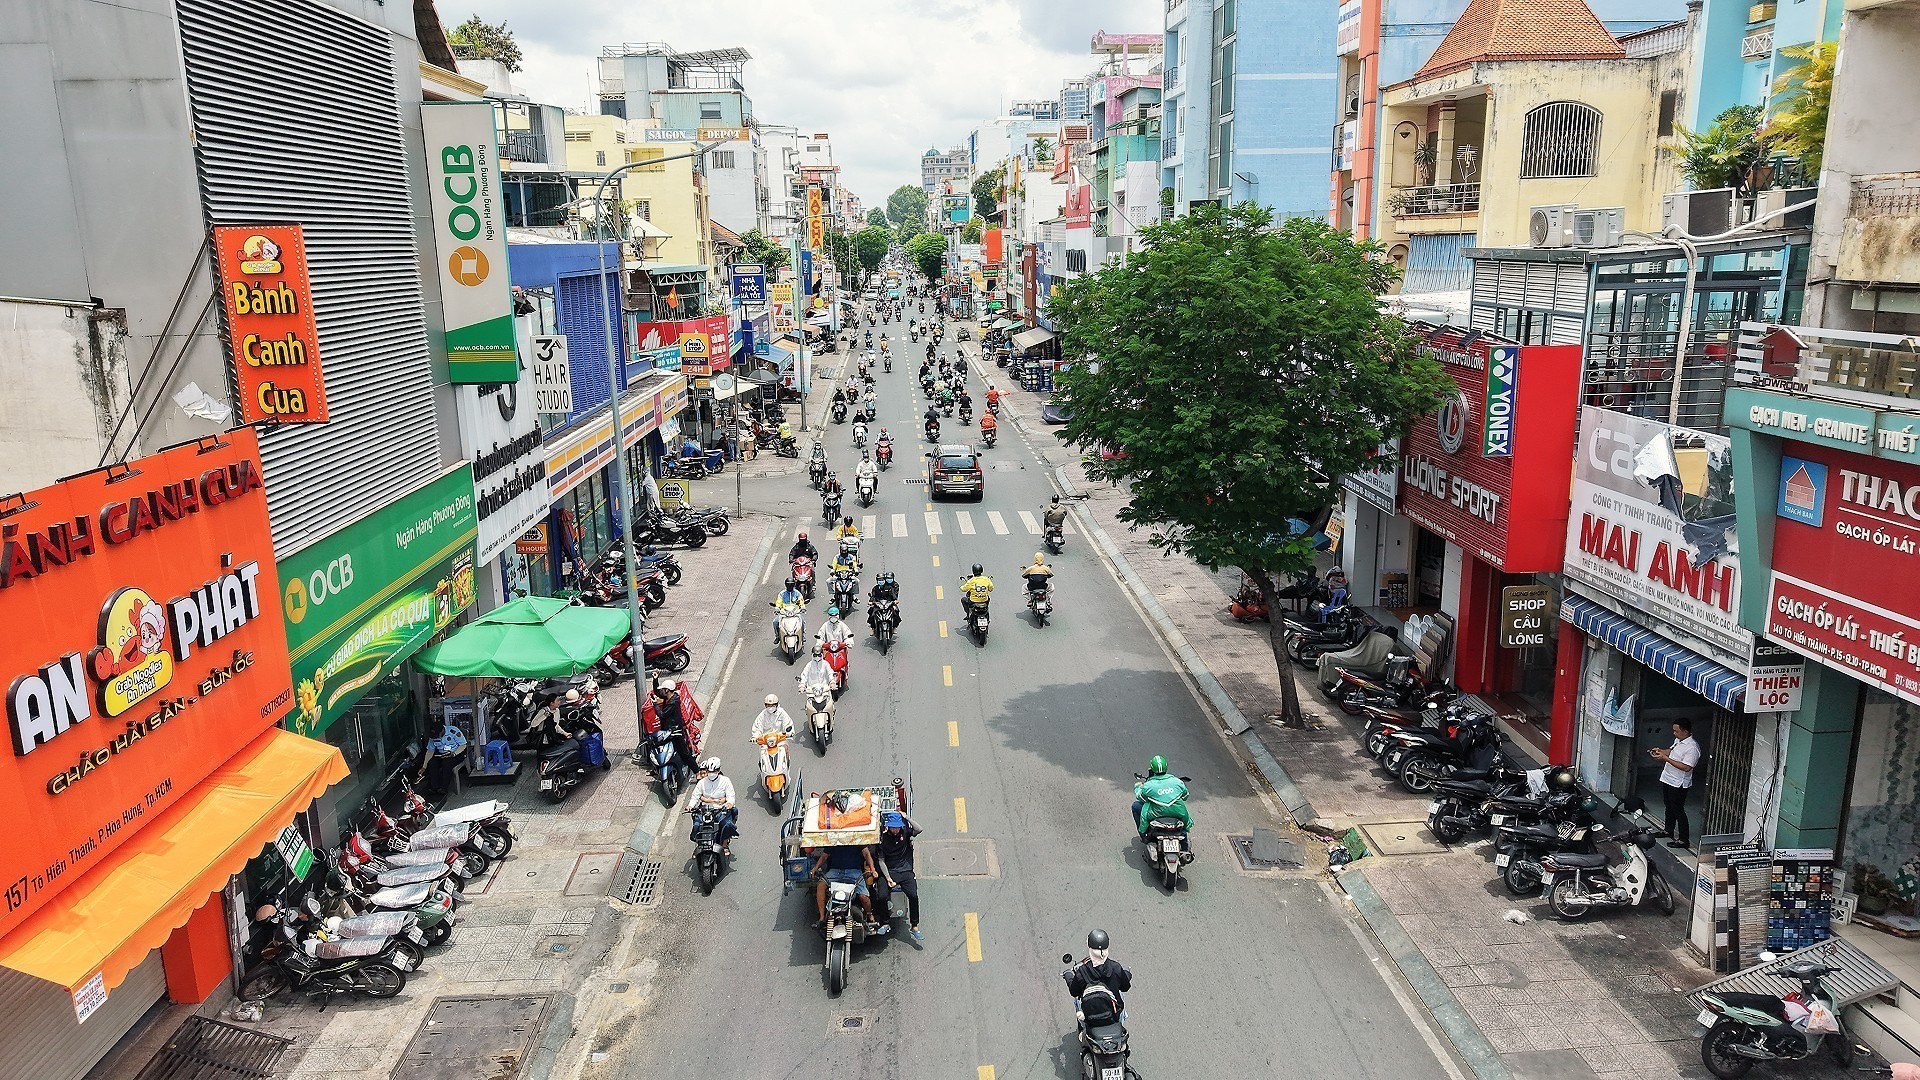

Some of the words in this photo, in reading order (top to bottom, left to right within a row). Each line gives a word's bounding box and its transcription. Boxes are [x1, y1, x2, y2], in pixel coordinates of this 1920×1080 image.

[648, 130, 687, 140] SAIGON
[707, 129, 740, 139] DEPOT
[478, 144, 486, 166] Đông
[441, 144, 481, 241] OCB
[480, 167, 488, 197] Phương
[484, 198, 492, 219] Hàng
[485, 220, 495, 241] Ngân
[232, 281, 298, 315] Bánh
[242, 332, 306, 367] Canh
[534, 363, 566, 384] HAIR
[1752, 375, 1808, 392] SHOWROOM
[257, 380, 306, 414] Cua
[536, 390, 569, 410] STUDIO
[1487, 390, 1512, 455] YONEX
[1750, 406, 1780, 428] GẠCH
[1782, 410, 1808, 432] MEN
[1814, 418, 1869, 445] GRANITE
[1878, 425, 1919, 454] THIẾT
[100, 478, 200, 544] CANH
[200, 460, 262, 506] CUA
[1452, 476, 1500, 525] SPORT
[1592, 492, 1612, 509] CÔNG
[1614, 500, 1623, 512] TY
[1625, 504, 1645, 521] TNHH
[396, 526, 416, 549] Ngân
[416, 518, 433, 534] Hàng
[432, 503, 455, 526] Phương
[455, 494, 471, 512] Đông
[1836, 521, 1870, 542] GẠCH
[1872, 527, 1890, 546] ỐP
[1892, 535, 1916, 554] LÁT
[1580, 511, 1642, 573] MAI
[1648, 540, 1735, 612] ANH
[309, 553, 354, 605] OCB
[1510, 600, 1546, 610] SHOP
[1614, 571, 1622, 582] CAO
[1720, 617, 1730, 630] CÁC
[354, 622, 374, 652] DỊCH
[1514, 614, 1540, 629] CẦU
[1777, 595, 1814, 620] GẠCH
[1814, 602, 1834, 632] ỐP
[1835, 615, 1860, 642] LÁT
[1869, 629, 1908, 660] THIẾT
[6, 651, 91, 756] AN
[166, 552, 260, 661] PHÁT
[1508, 632, 1544, 645] LÔNG
[1772, 623, 1783, 636] 140
[1784, 628, 1792, 639] TÔ
[1794, 630, 1807, 646] HIẾN
[1807, 637, 1828, 654] THÀNH
[1862, 660, 1887, 680] TP.HCM
[116, 676, 133, 695] Crab
[133, 659, 162, 685] Noodles
[138, 676, 156, 696] Phát
[1753, 674, 1800, 690] THIÊN
[1759, 690, 1789, 708] LỘC
[46, 751, 110, 796] CHÁO
[199, 667, 232, 696] BÚN
[232, 649, 255, 674] ỐC
[1158, 787, 1174, 796] Grab
[4, 876, 30, 914] 157
[30, 874, 44, 894] Tô
[46, 857, 67, 881] Hiến
[69, 834, 98, 865] Thành,
[98, 819, 121, 844] P.Hòa
[122, 802, 145, 832] Hưng,
[144, 777, 173, 808] Tp.HCM
